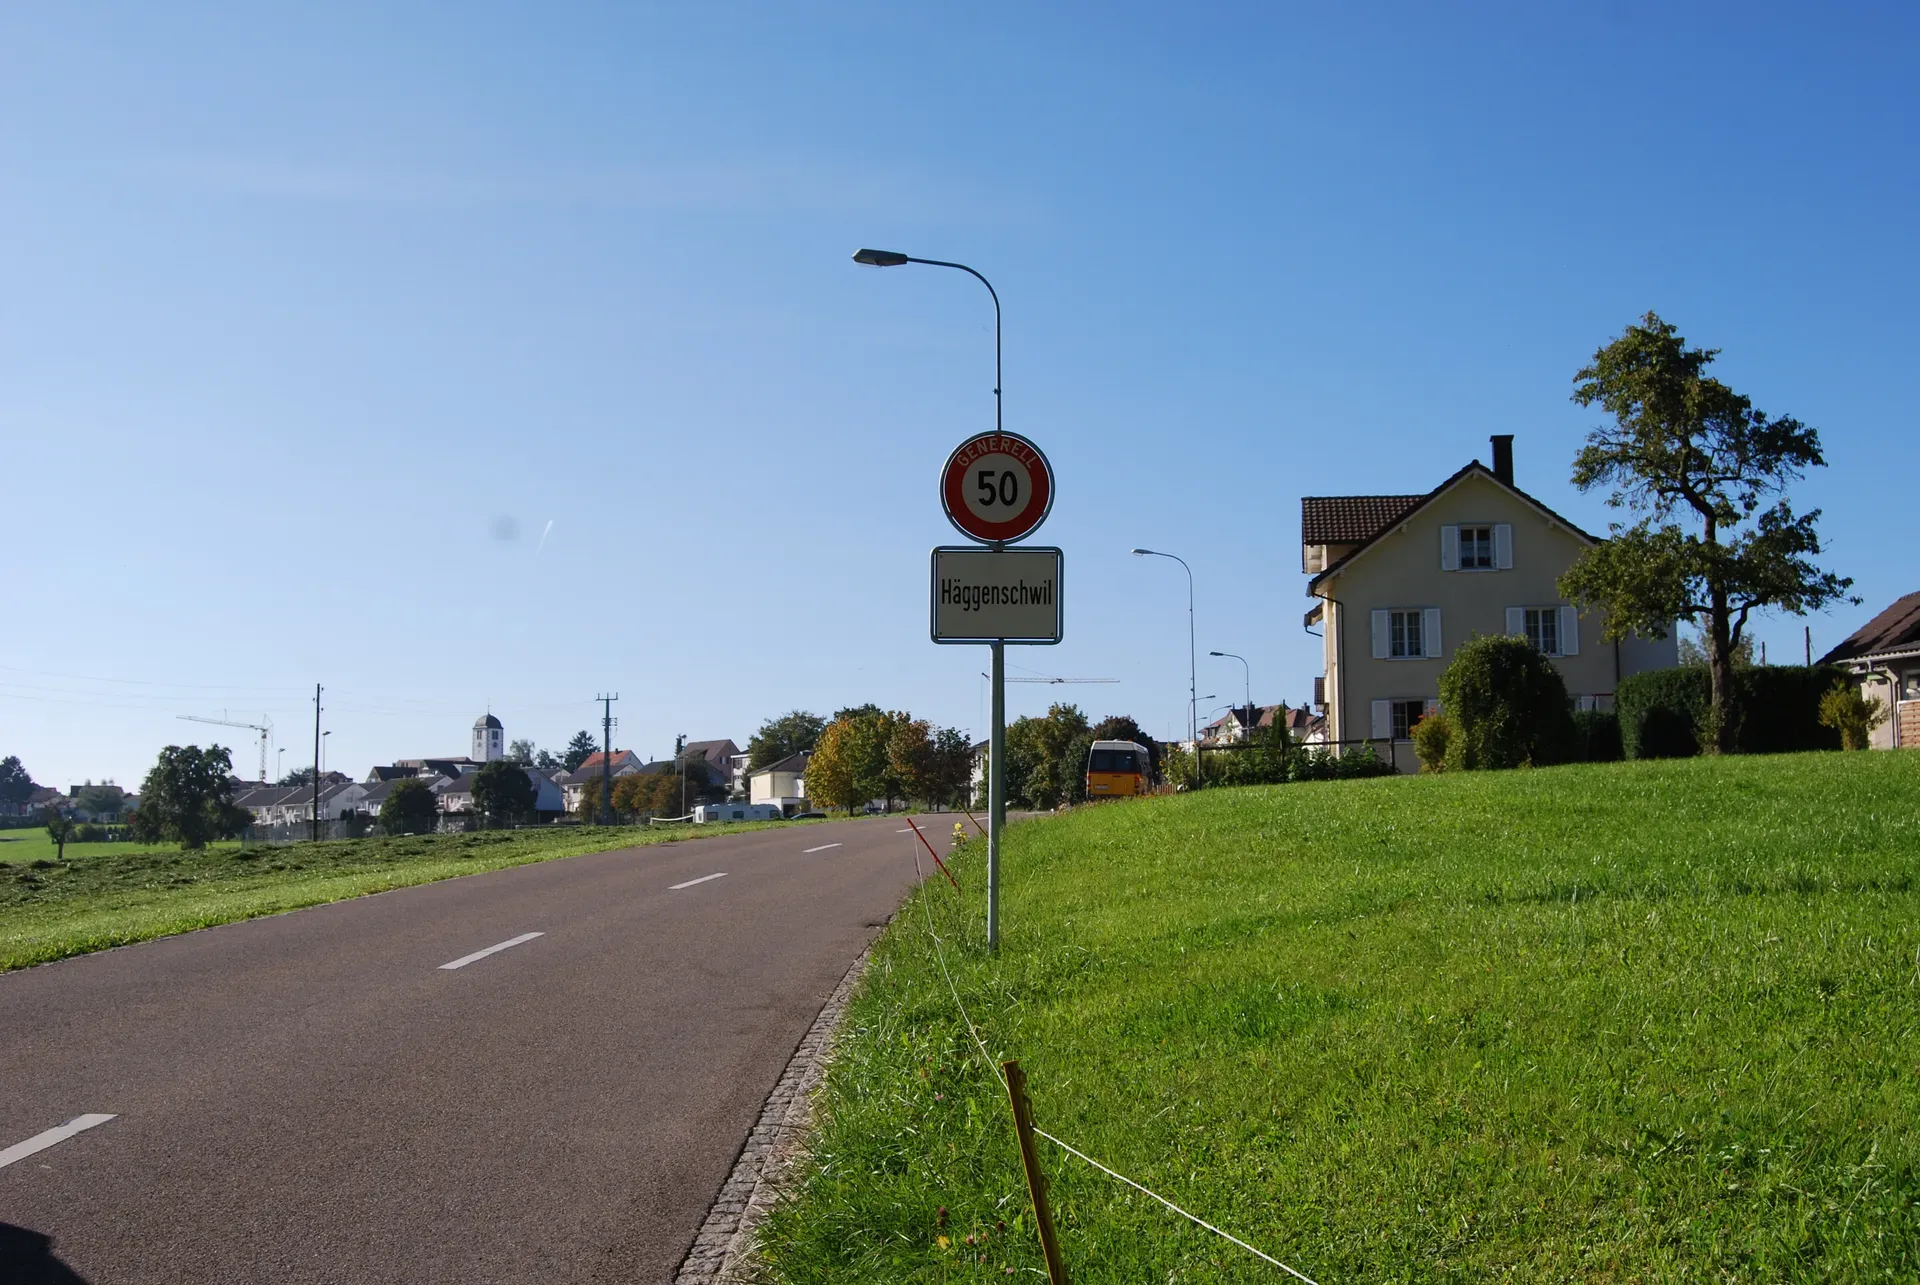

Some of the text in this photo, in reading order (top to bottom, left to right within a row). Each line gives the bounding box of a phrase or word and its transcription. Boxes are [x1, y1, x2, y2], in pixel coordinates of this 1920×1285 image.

[956, 437, 1039, 469] GENERELL
[977, 470, 1018, 507] 50
[941, 578, 1052, 612] Häggenschwil
